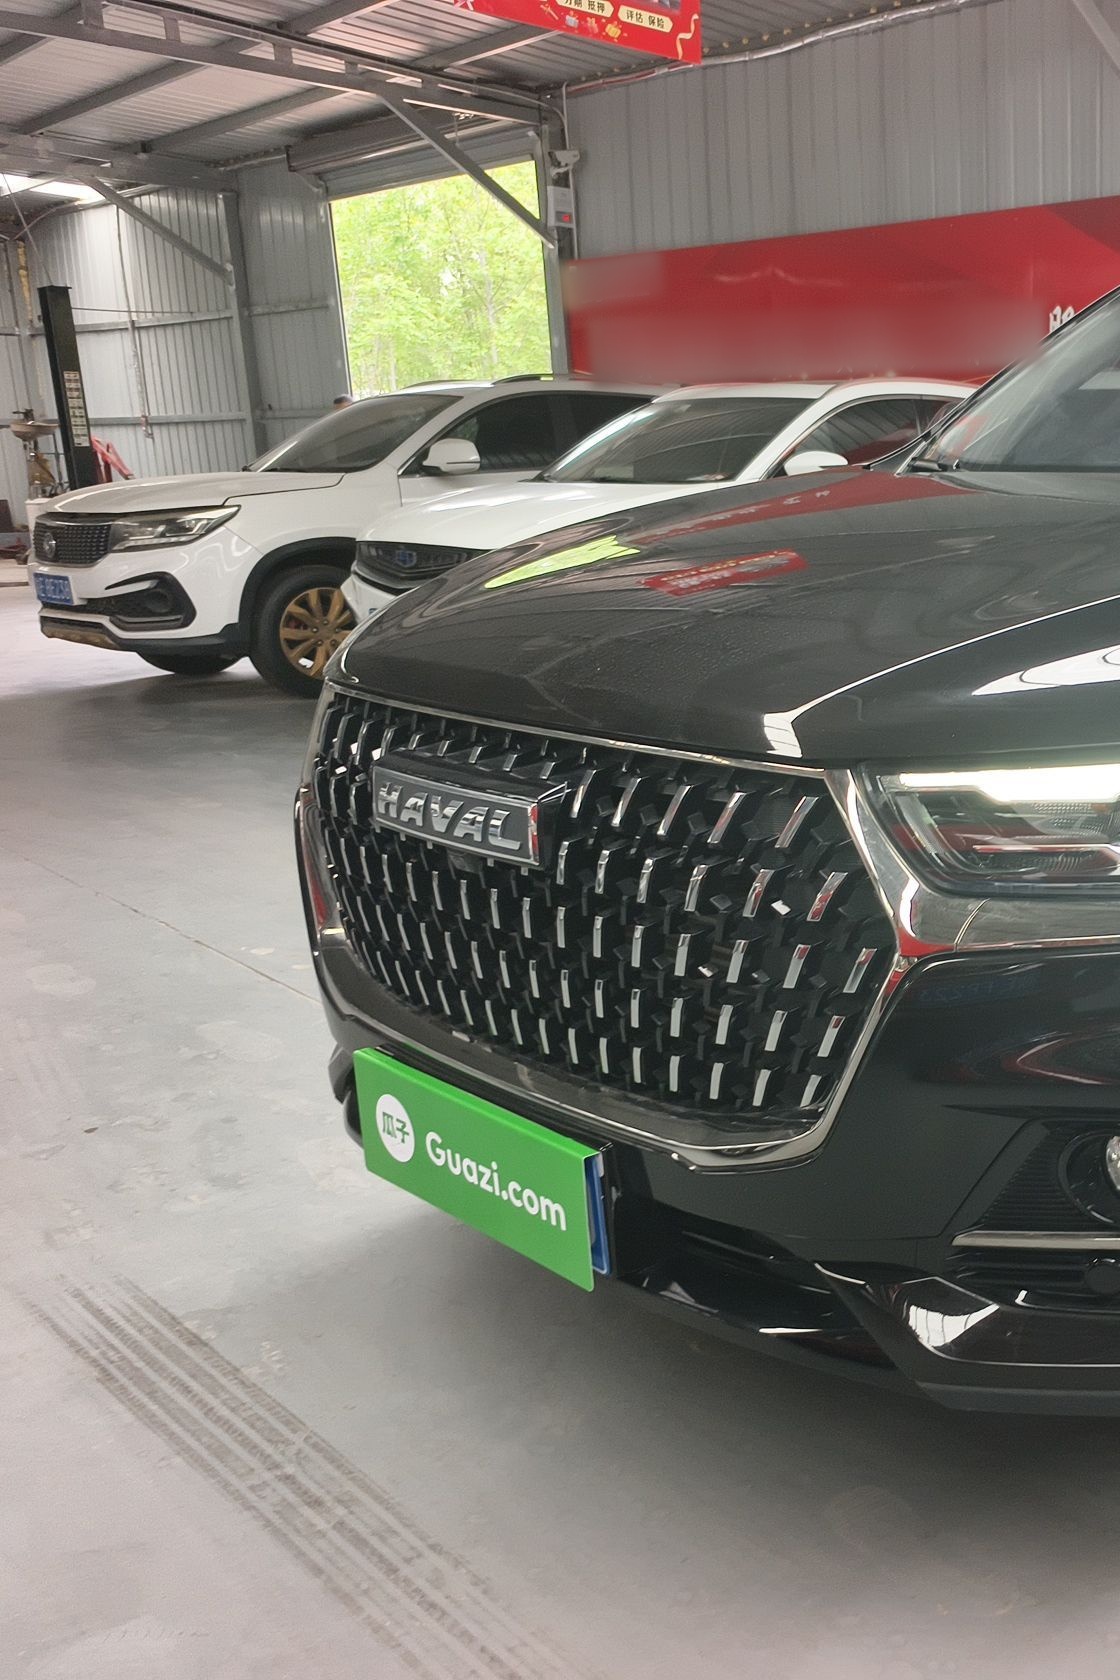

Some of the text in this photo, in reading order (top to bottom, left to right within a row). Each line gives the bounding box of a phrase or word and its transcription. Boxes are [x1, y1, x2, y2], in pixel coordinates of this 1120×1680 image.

[626, 9, 665, 29] 评估 保险
[377, 781, 522, 851] HAVAL
[382, 1111, 410, 1144] 瓜子
[425, 1131, 567, 1231] Guazi.com
